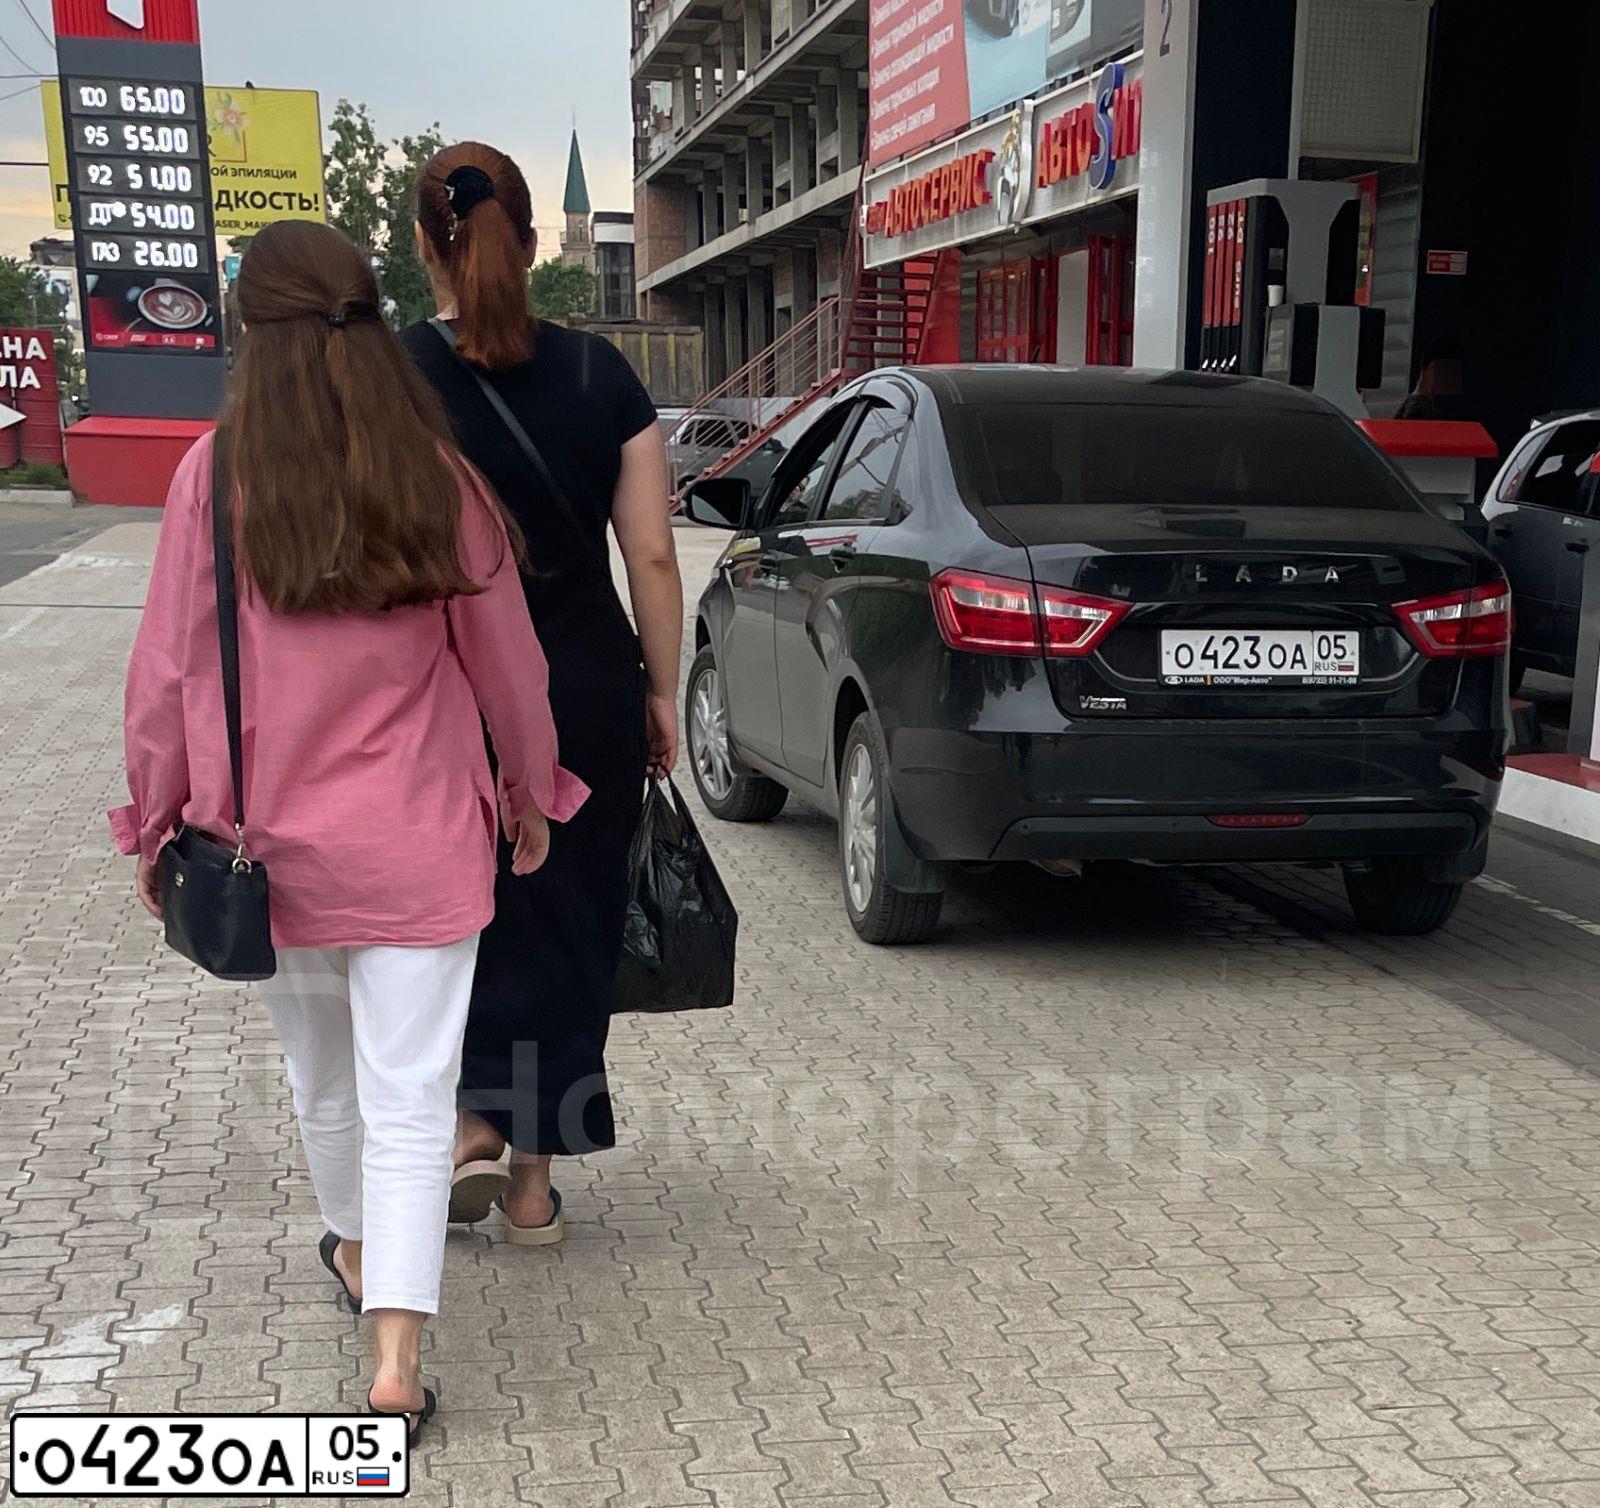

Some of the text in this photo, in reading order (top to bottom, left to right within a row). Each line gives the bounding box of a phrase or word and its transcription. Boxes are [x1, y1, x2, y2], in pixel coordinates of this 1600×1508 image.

[80, 85, 186, 114] 100 65.00
[84, 125, 109, 146] 95
[123, 124, 189, 153] 55.00
[88, 163, 192, 191] 92 51.00
[211, 165, 297, 180] ОЙ ЭПИЛЯЦИИ
[55, 184, 320, 212] П ДКОСТЬ!
[885, 149, 996, 238] АВТОСЕРВИС
[131, 202, 195, 230] 54.00
[135, 241, 198, 268] 26.00
[0, 336, 47, 360] НА
[1195, 565, 1340, 583] LADA
[1317, 635, 1347, 660] 05
[1314, 661, 1337, 672] RUS
[1079, 695, 1127, 711] VESTA
